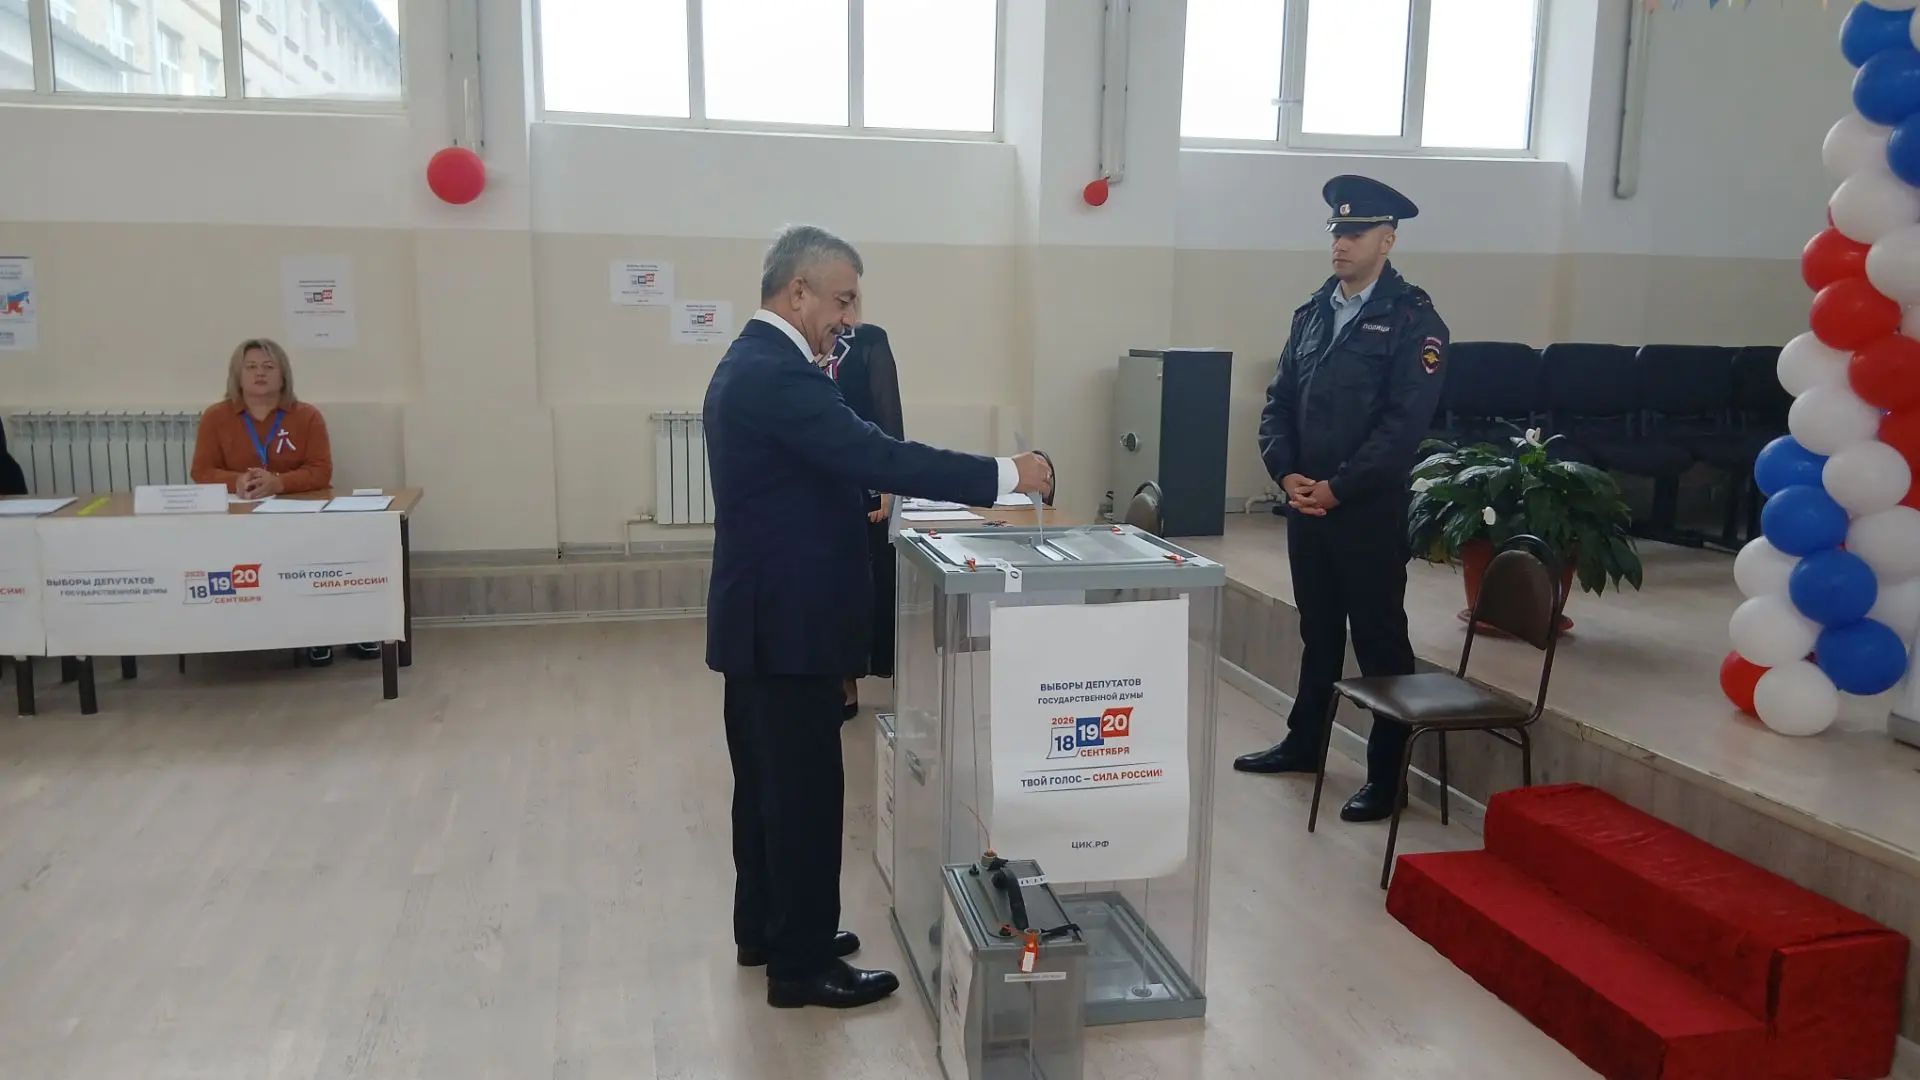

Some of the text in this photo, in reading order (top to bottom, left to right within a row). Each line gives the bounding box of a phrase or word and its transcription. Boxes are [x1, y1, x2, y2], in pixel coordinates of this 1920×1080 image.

[46, 576, 155, 587] ВЫБОРЫ ДЕПУТАТОВ
[232, 568, 257, 584] 20
[278, 569, 306, 580] ТВОЙ
[309, 570, 343, 579] ГОЛОС
[210, 576, 231, 592] 19
[312, 576, 388, 588] СИЛА РОССИИ!
[188, 585, 208, 599] 18
[1040, 678, 1142, 692] ВЫБОРЫ ДЕПУТАТОВ
[1038, 691, 1144, 704] ГОСУДАРСТВЕННОЙ ДУМЫ
[1051, 716, 1075, 725] 2026
[1102, 713, 1129, 732] 20
[1078, 723, 1099, 741] 19
[1054, 735, 1075, 752] 18
[1080, 746, 1130, 758] СЕНТЯБРЯ
[1020, 776, 1048, 788] ТВОЙ
[1049, 775, 1082, 786] ГОЛОС
[1092, 772, 1119, 783] СИЛА
[1120, 769, 1163, 780] РОССИИ!
[1071, 840, 1110, 850] ЦИК.РФ
